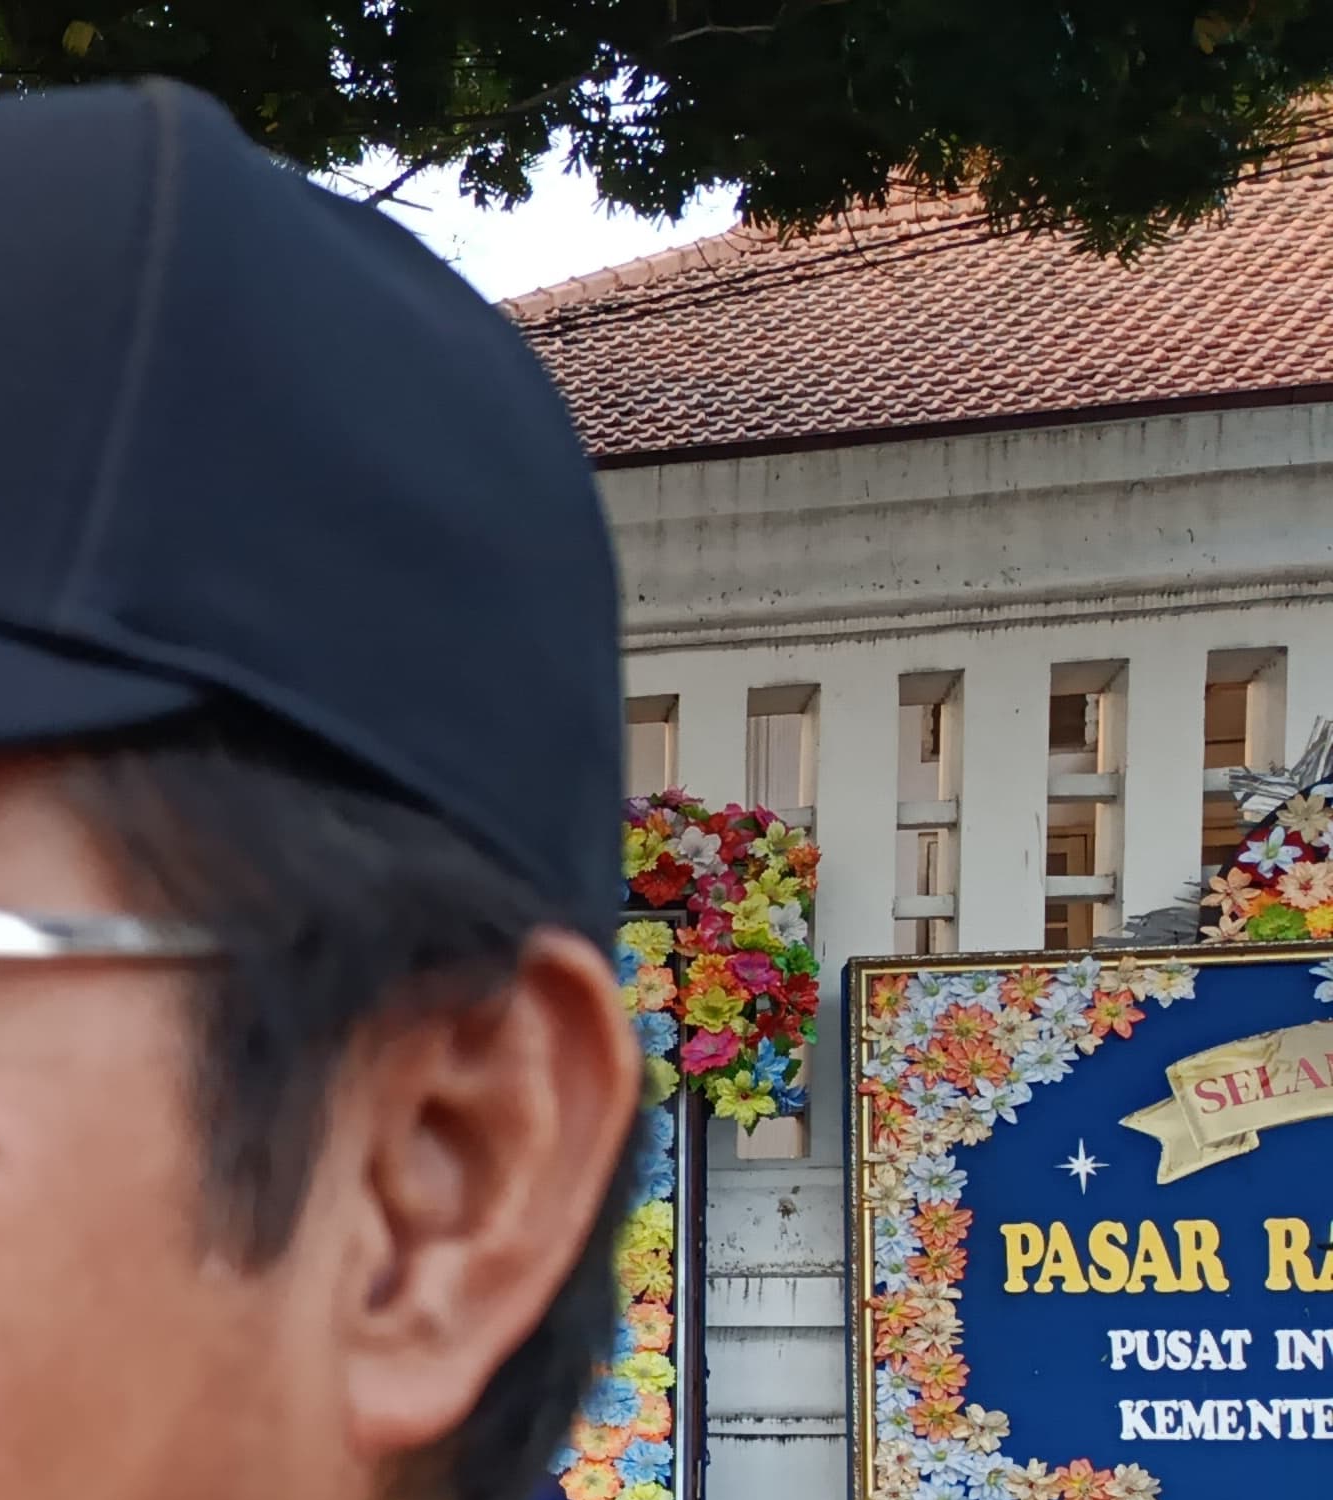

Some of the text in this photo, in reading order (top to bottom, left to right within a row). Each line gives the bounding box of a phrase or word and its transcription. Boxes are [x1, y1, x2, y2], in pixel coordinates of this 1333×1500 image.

[1194, 1052, 1333, 1114] SELA
[1000, 1219, 1229, 1293] PASAR
[1107, 1328, 1253, 1371] PUSAT
